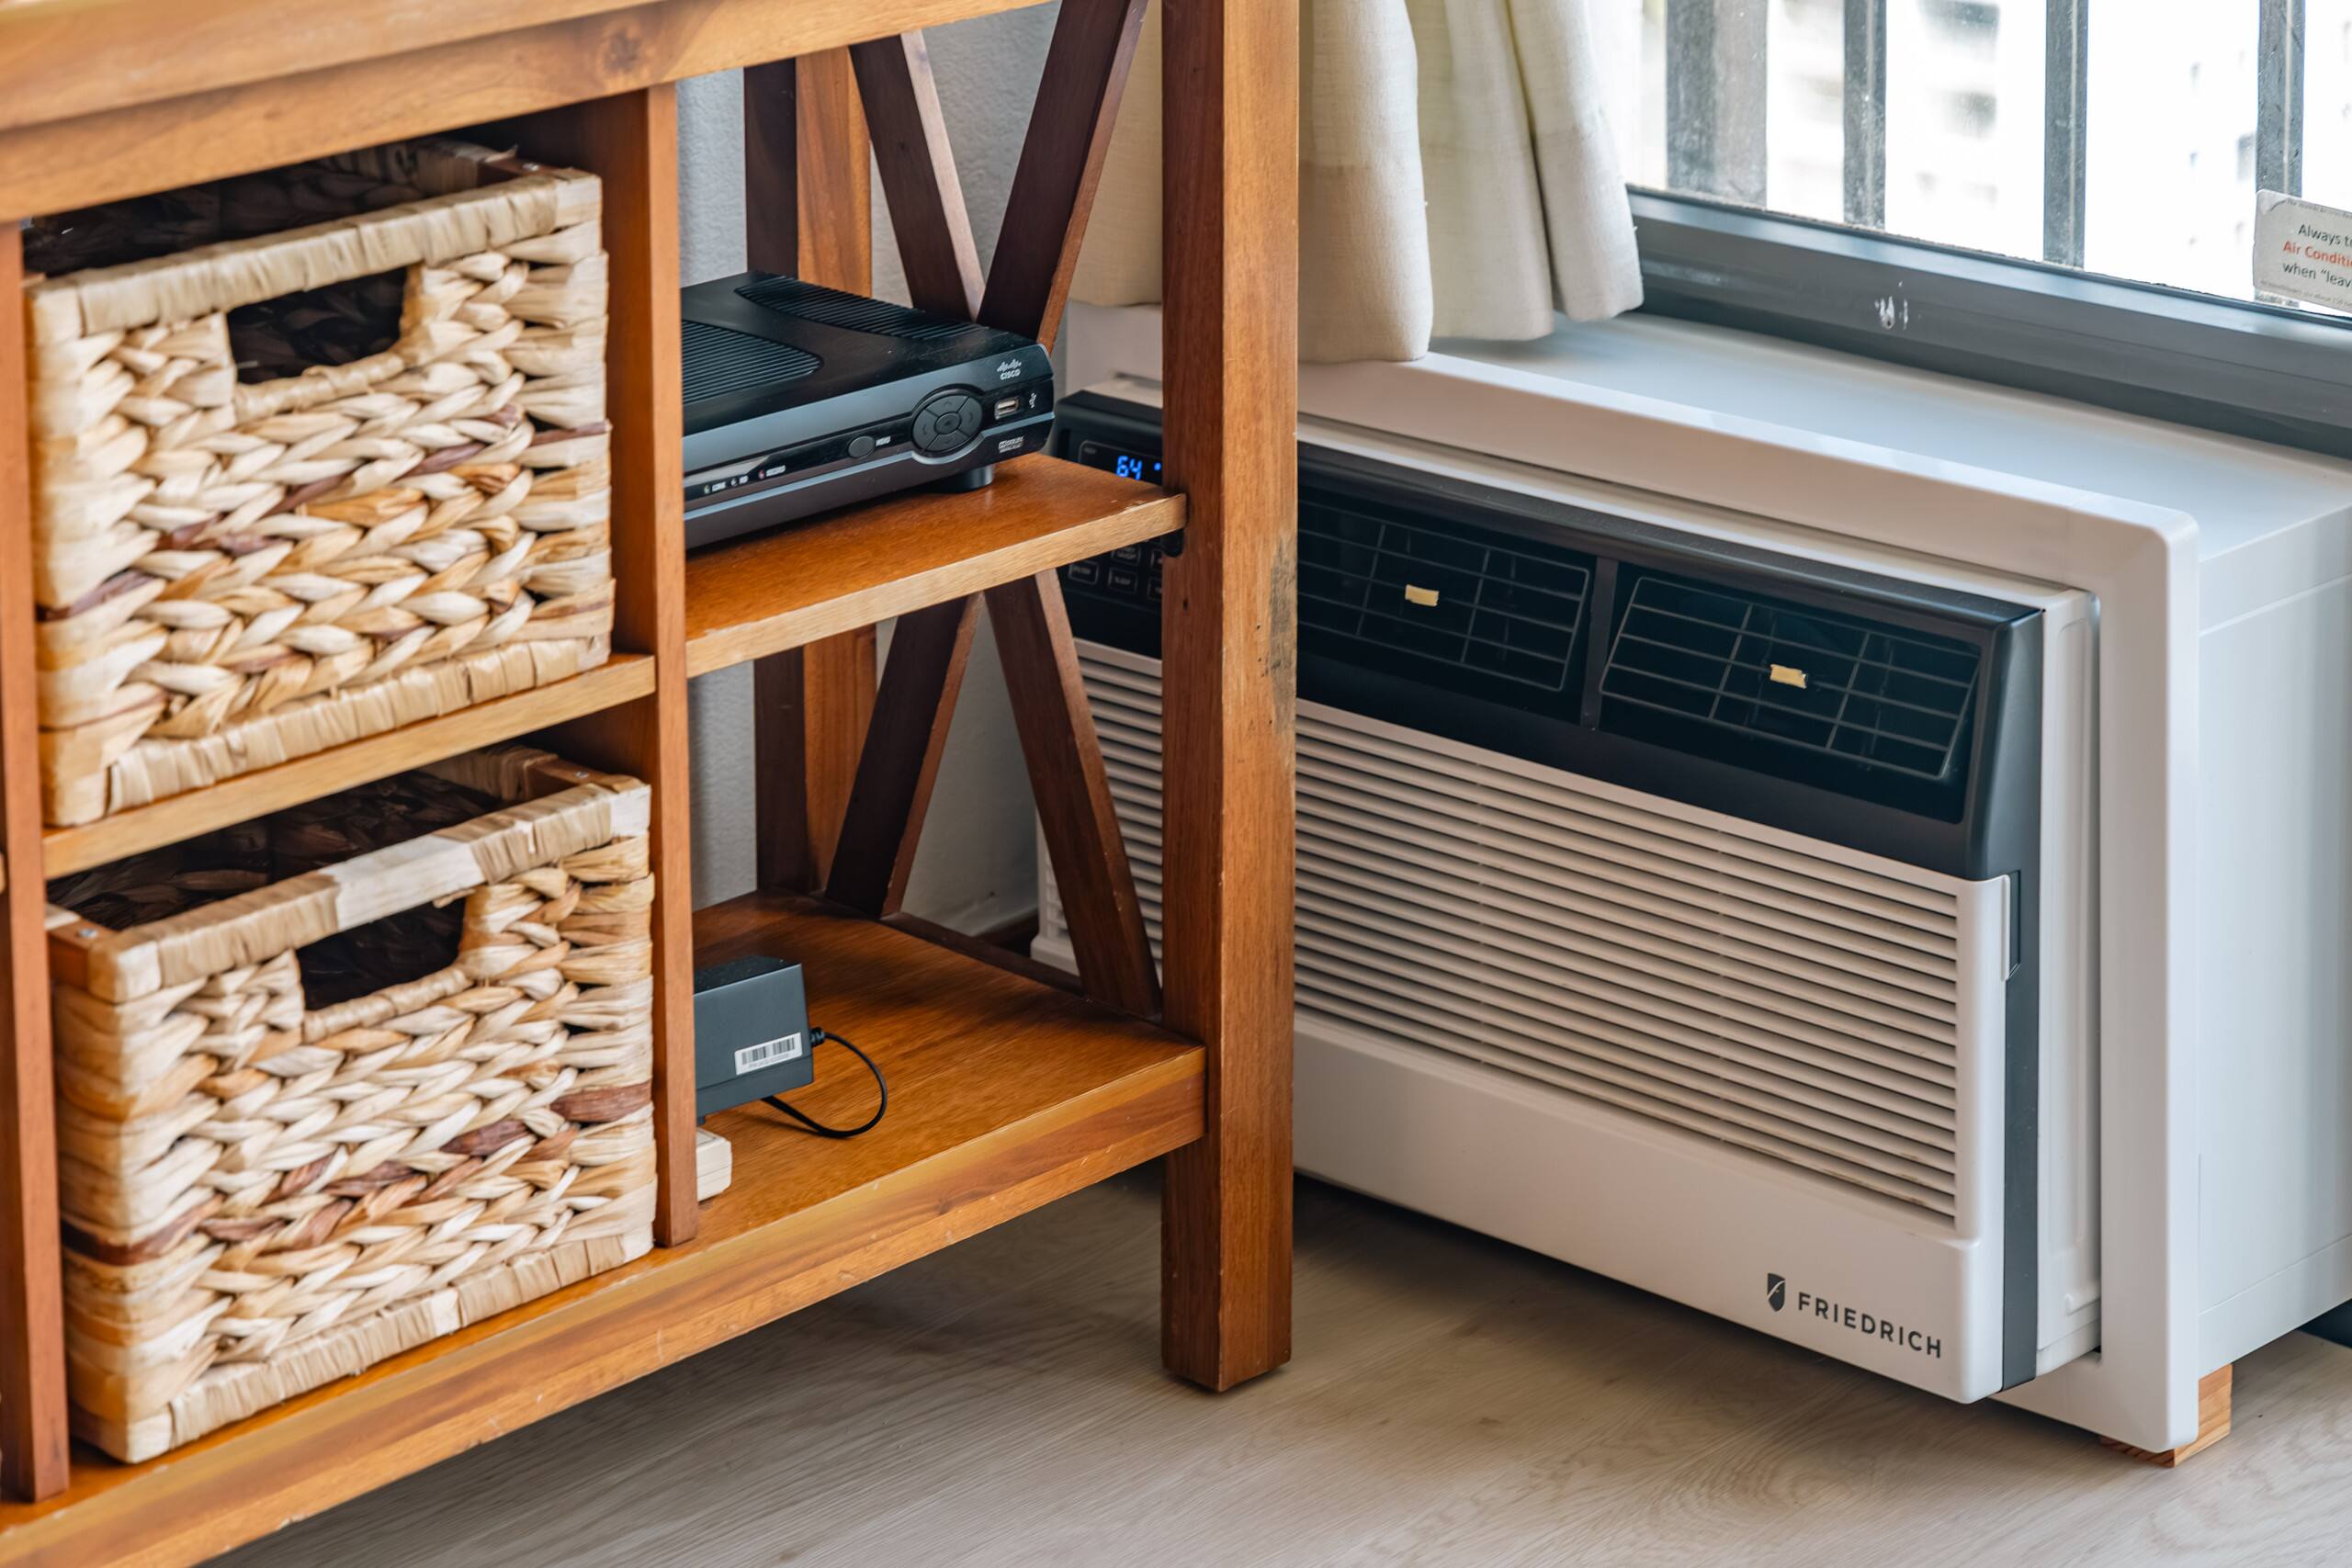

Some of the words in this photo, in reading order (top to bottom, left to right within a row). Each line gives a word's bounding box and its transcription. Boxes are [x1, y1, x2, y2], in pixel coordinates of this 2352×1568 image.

[2298, 224, 2341, 246] Always
[2282, 241, 2301, 254] Air
[2304, 245, 2352, 268] Conditi
[2282, 263, 2316, 279] when
[1116, 456, 1142, 480] 64
[1798, 1292, 1940, 1359] FRIEDRICH
